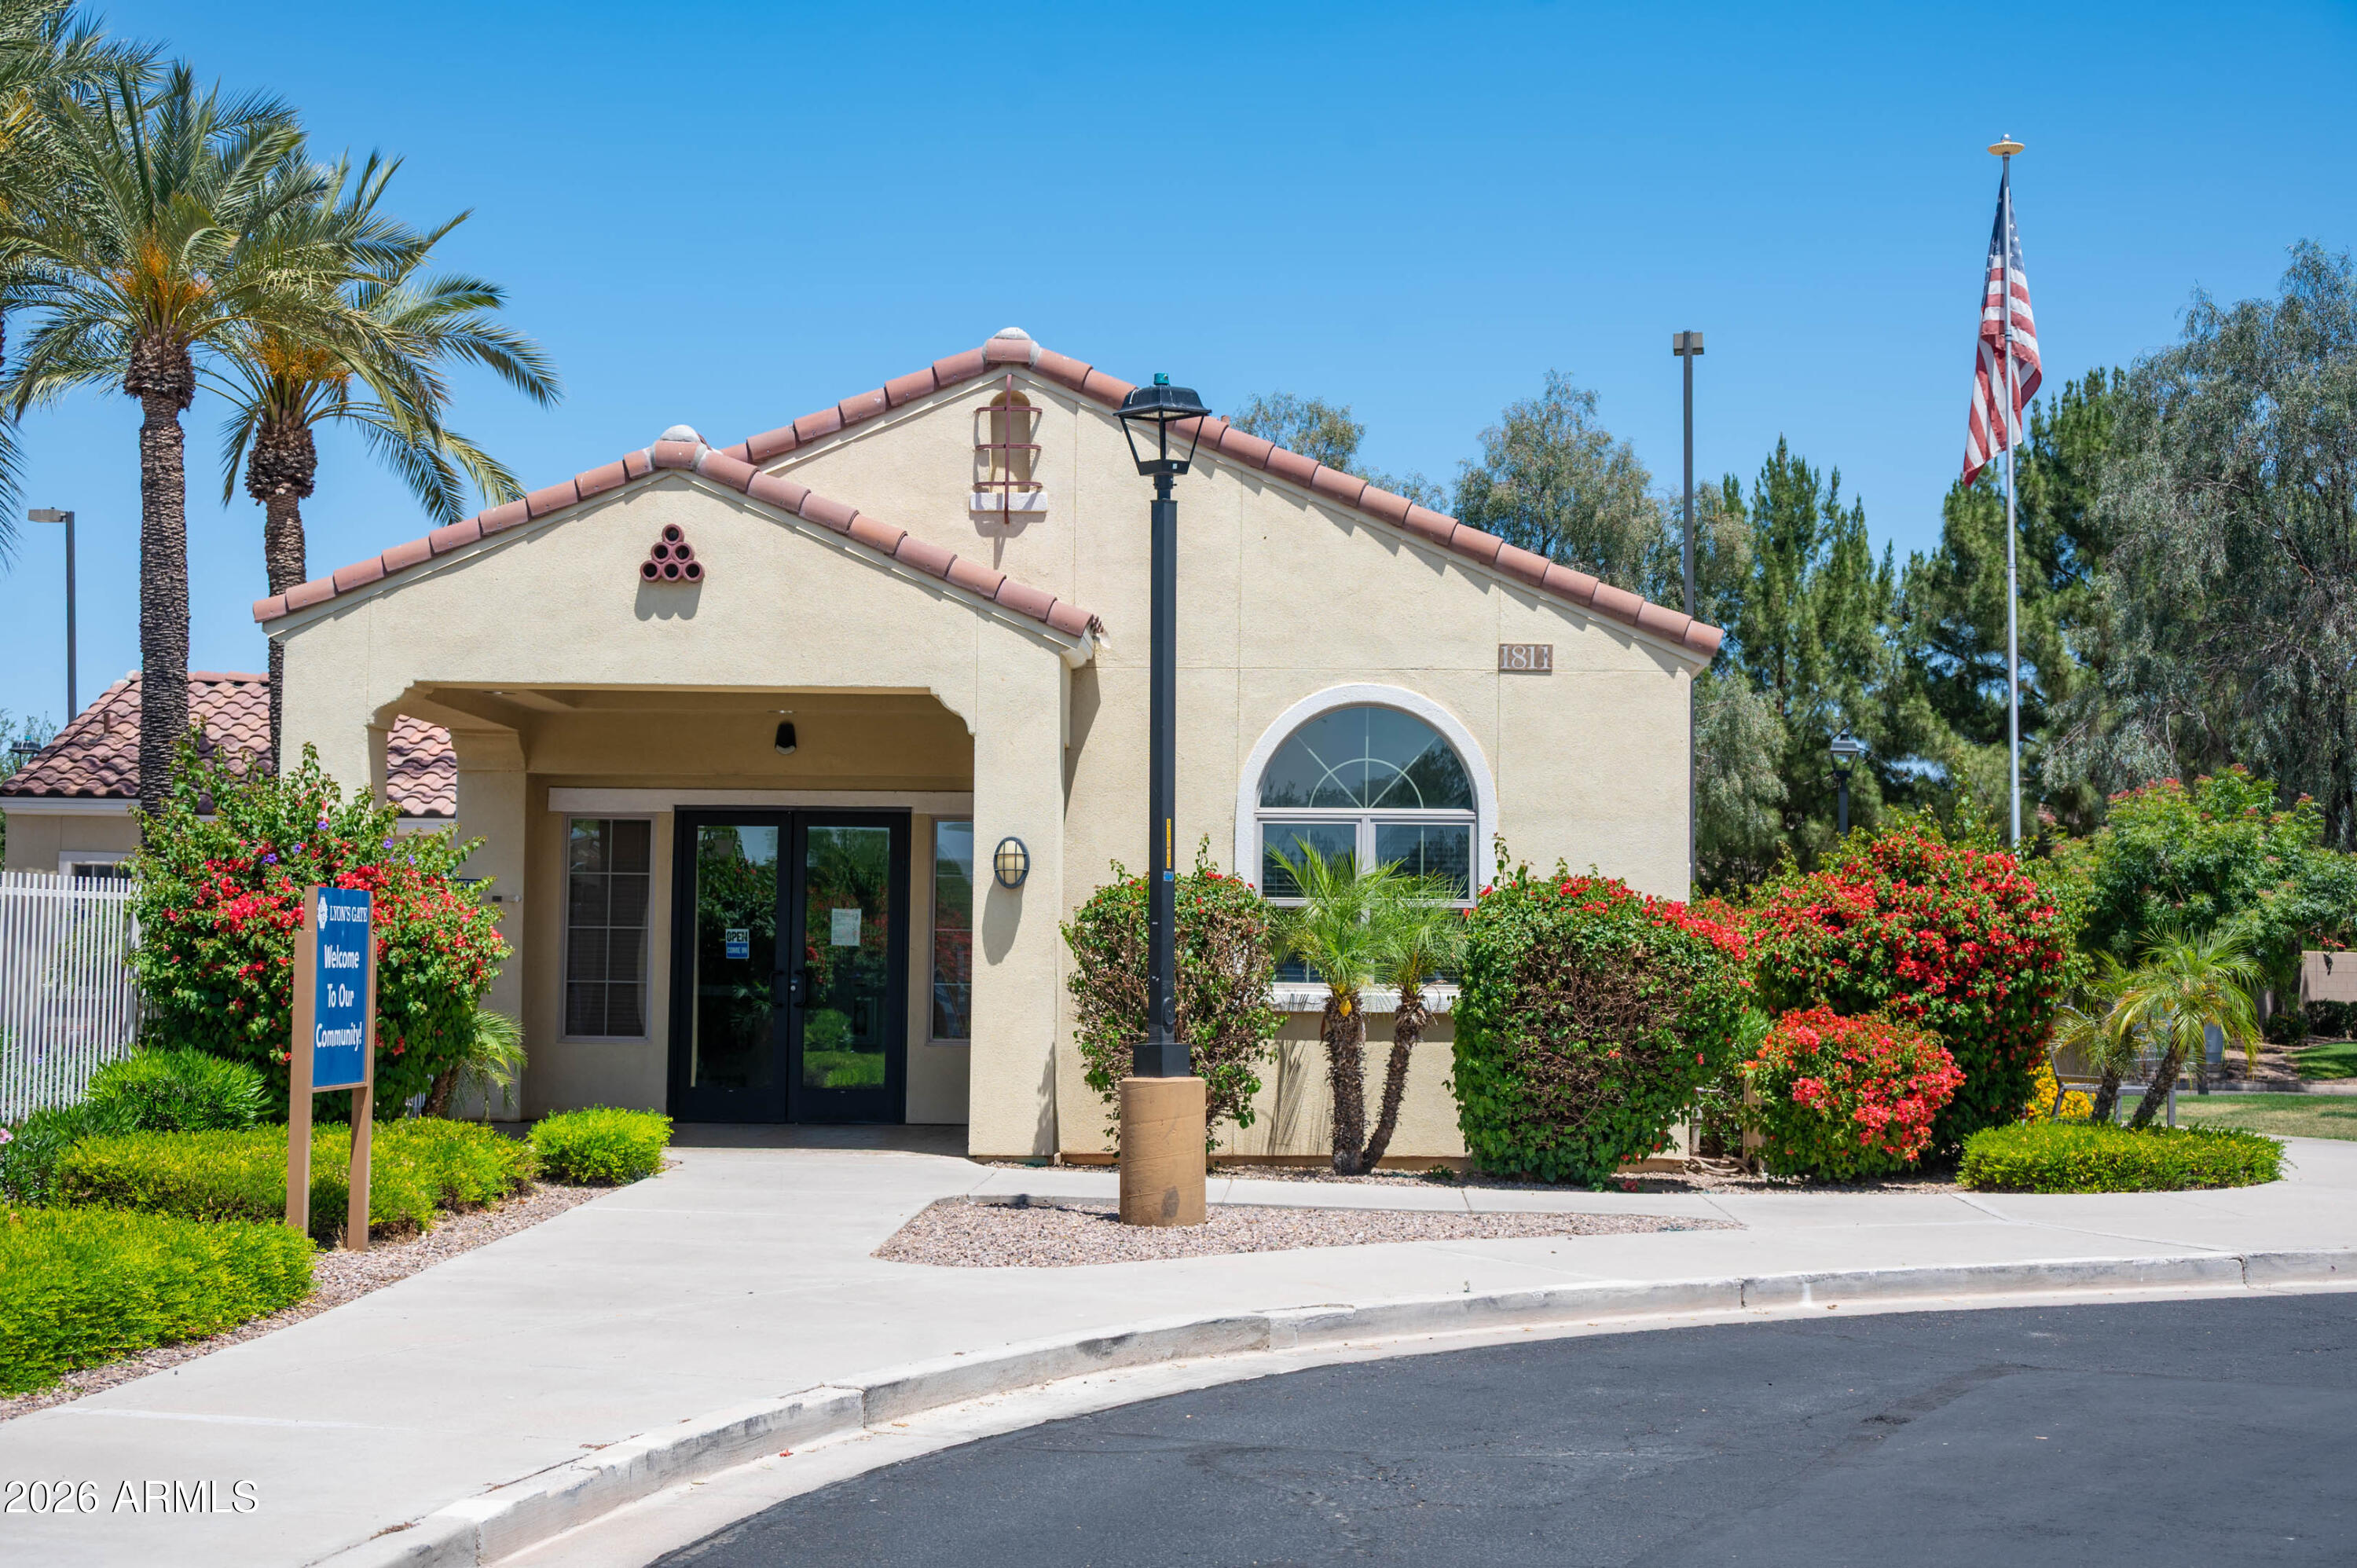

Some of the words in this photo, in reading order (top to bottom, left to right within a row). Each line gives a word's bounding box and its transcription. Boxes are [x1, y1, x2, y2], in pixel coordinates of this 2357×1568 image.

[1501, 645, 1552, 669] 1811
[329, 905, 350, 922] LYON'S
[351, 906, 368, 923] GATE
[727, 931, 748, 942] OPEN
[324, 944, 359, 969] Welcome
[327, 983, 336, 1008] To
[339, 983, 354, 1008] Our
[316, 1021, 362, 1052] Community!
